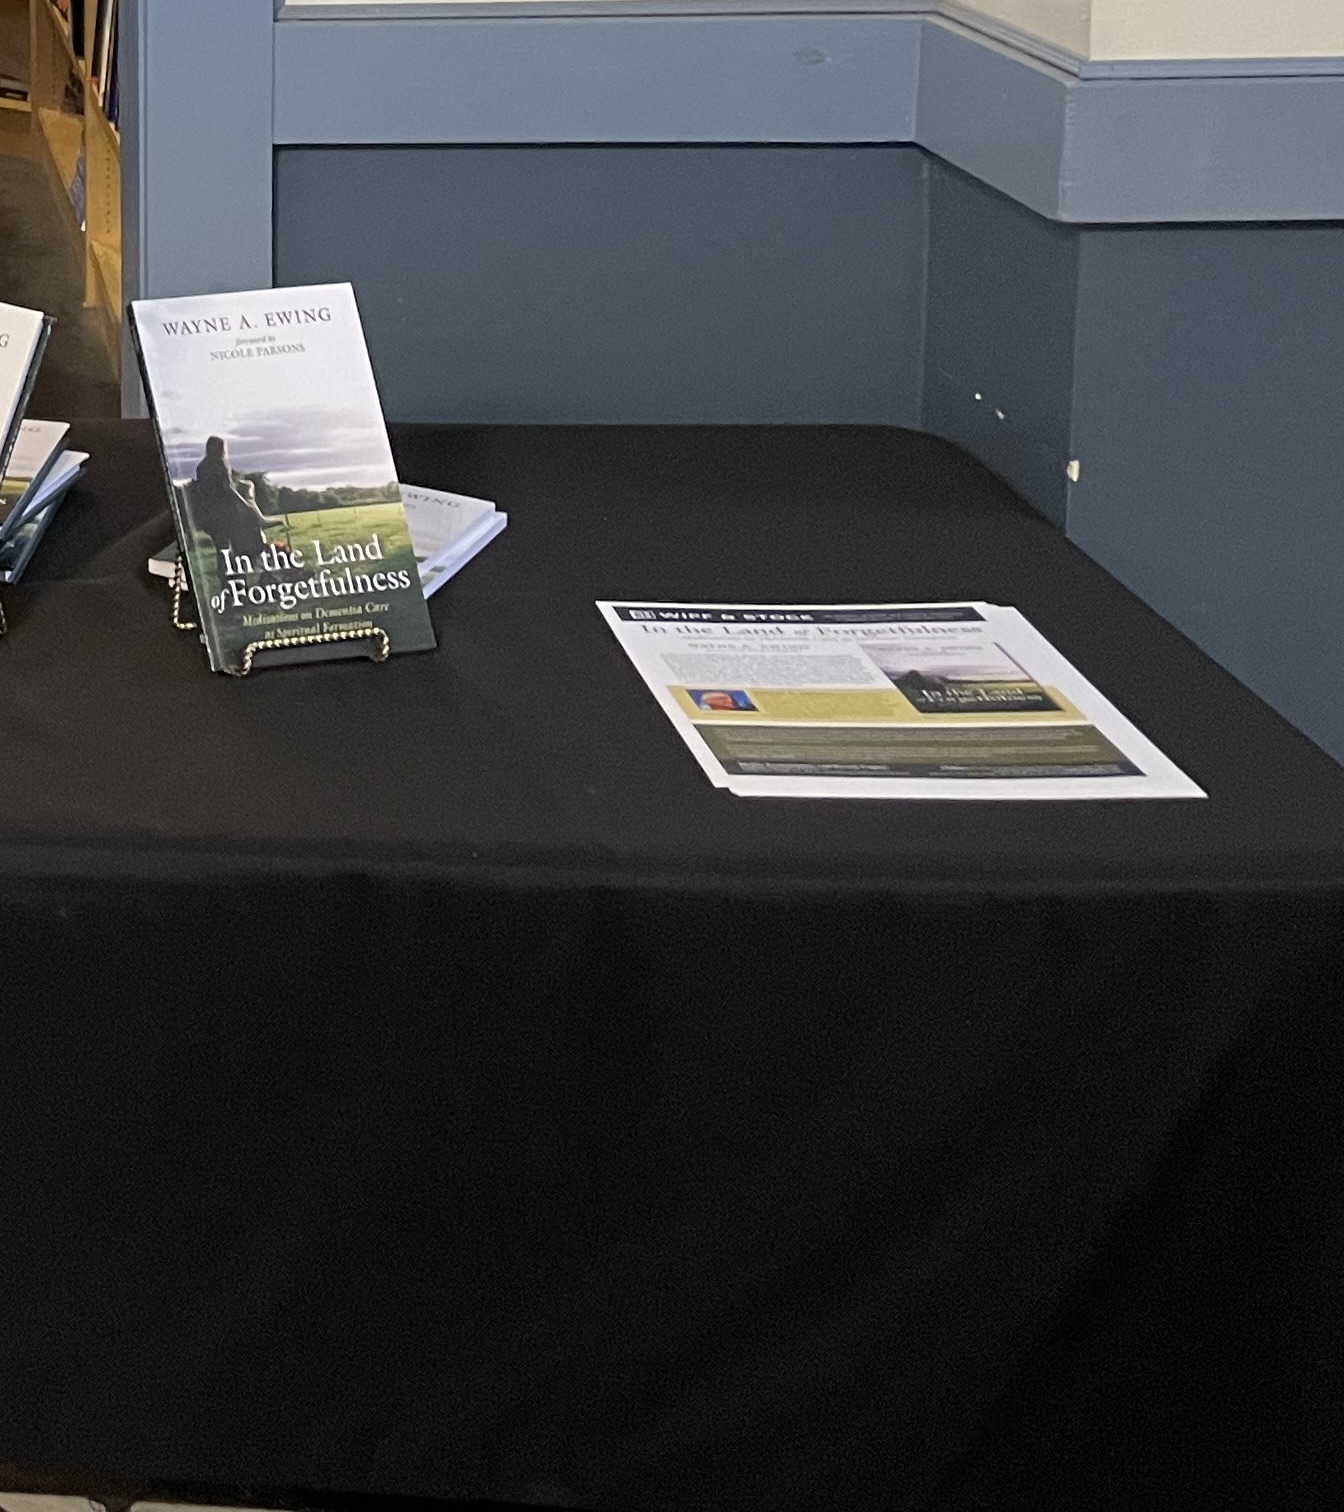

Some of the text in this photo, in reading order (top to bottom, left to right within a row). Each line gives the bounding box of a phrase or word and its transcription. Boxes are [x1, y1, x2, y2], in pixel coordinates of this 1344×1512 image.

[162, 307, 332, 336] WAYNE A. EWING
[209, 343, 305, 361] NICOLE PARSONS
[220, 533, 384, 576] In the Land
[211, 567, 411, 614] of Forgetfulness
[315, 603, 363, 619] Dementia
[365, 601, 390, 614] Care
[642, 625, 667, 634] In
[676, 625, 712, 634] the
[723, 626, 784, 635] Land
[816, 625, 983, 638] Forgetfulness
